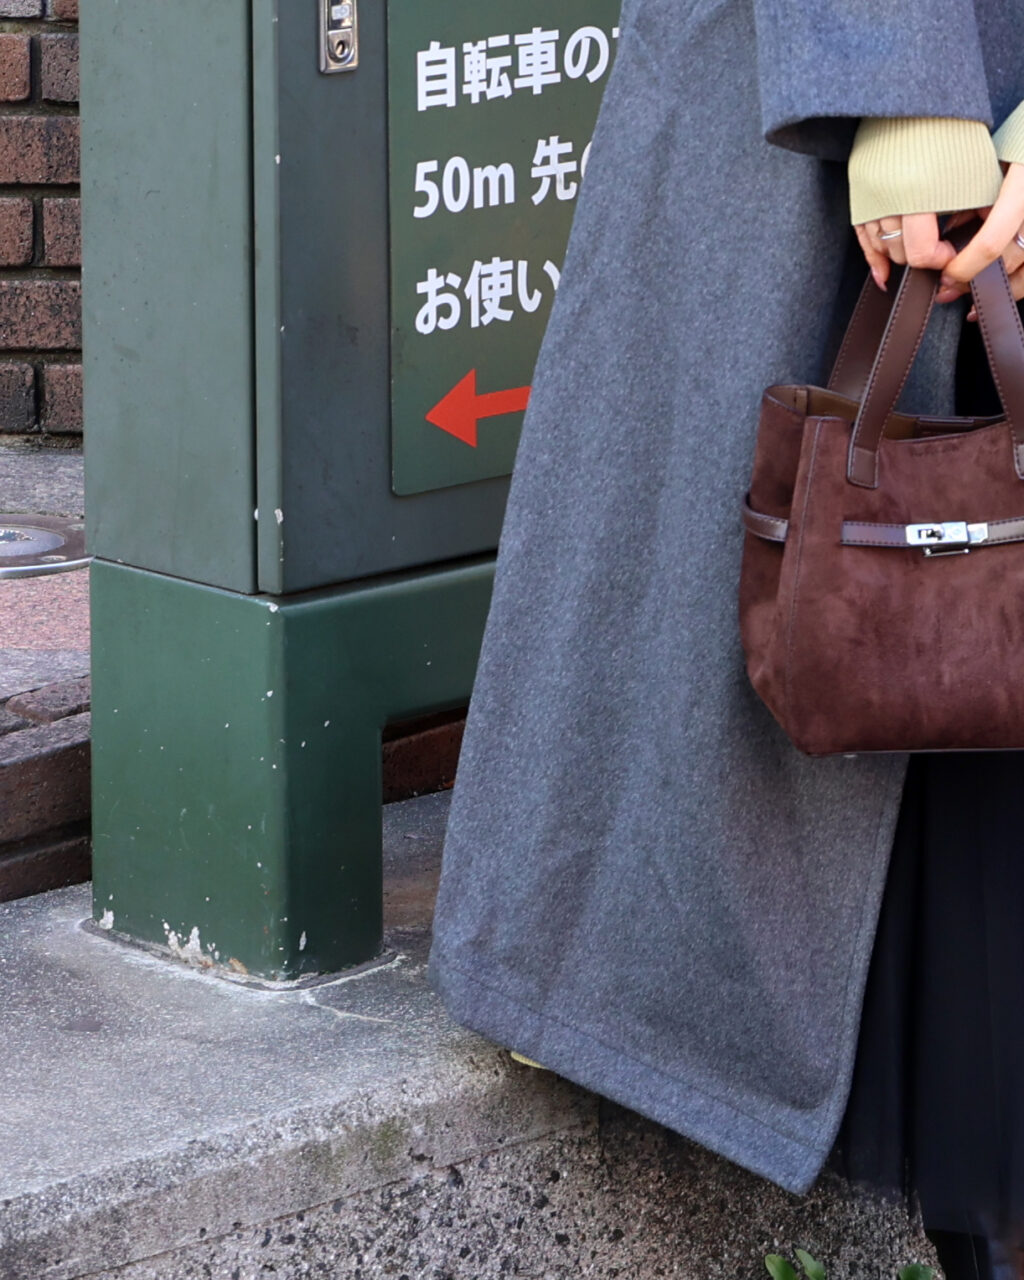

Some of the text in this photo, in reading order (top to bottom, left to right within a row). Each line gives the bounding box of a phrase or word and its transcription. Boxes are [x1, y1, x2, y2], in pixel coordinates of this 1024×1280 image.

[416, 26, 621, 111] 自転車の
[413, 135, 594, 218] 50m 先
